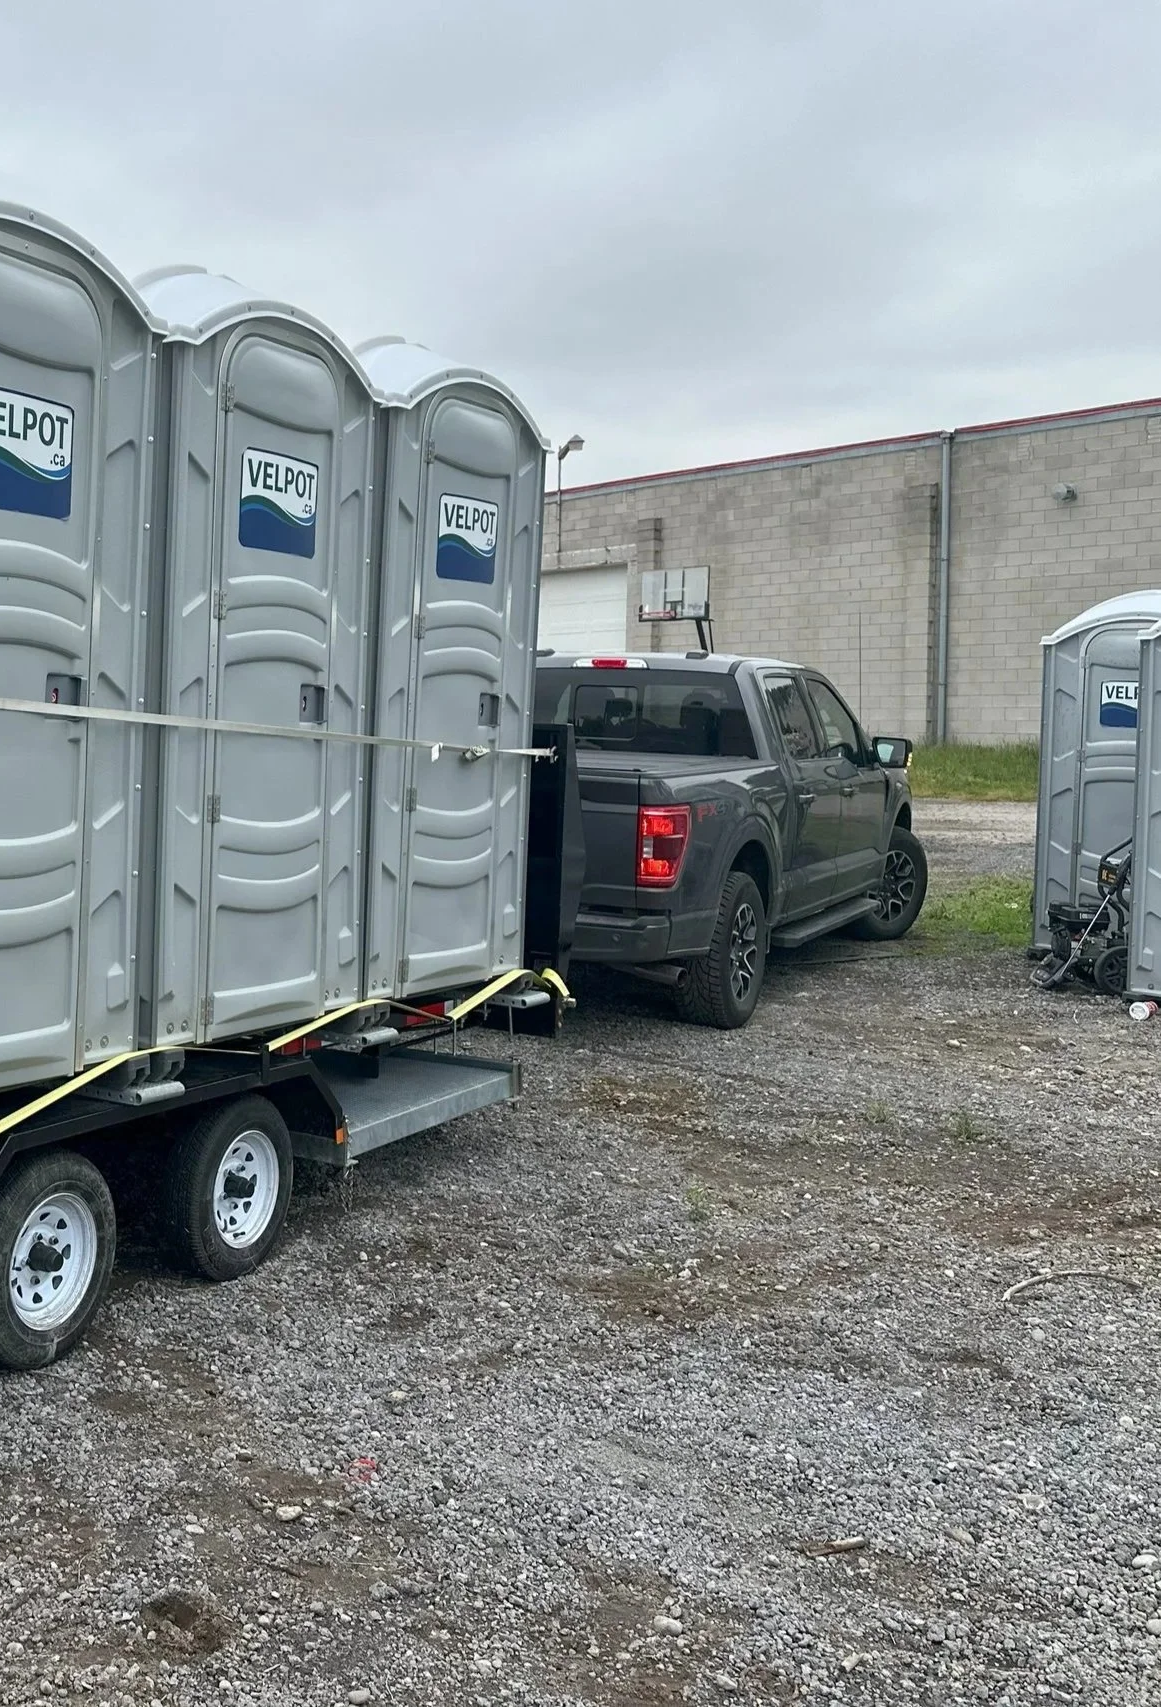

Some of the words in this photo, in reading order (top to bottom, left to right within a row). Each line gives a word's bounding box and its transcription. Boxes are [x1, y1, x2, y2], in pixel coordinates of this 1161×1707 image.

[49, 453, 65, 467] .ca
[247, 458, 315, 501] VELPOT
[444, 502, 496, 535] VELPOT
